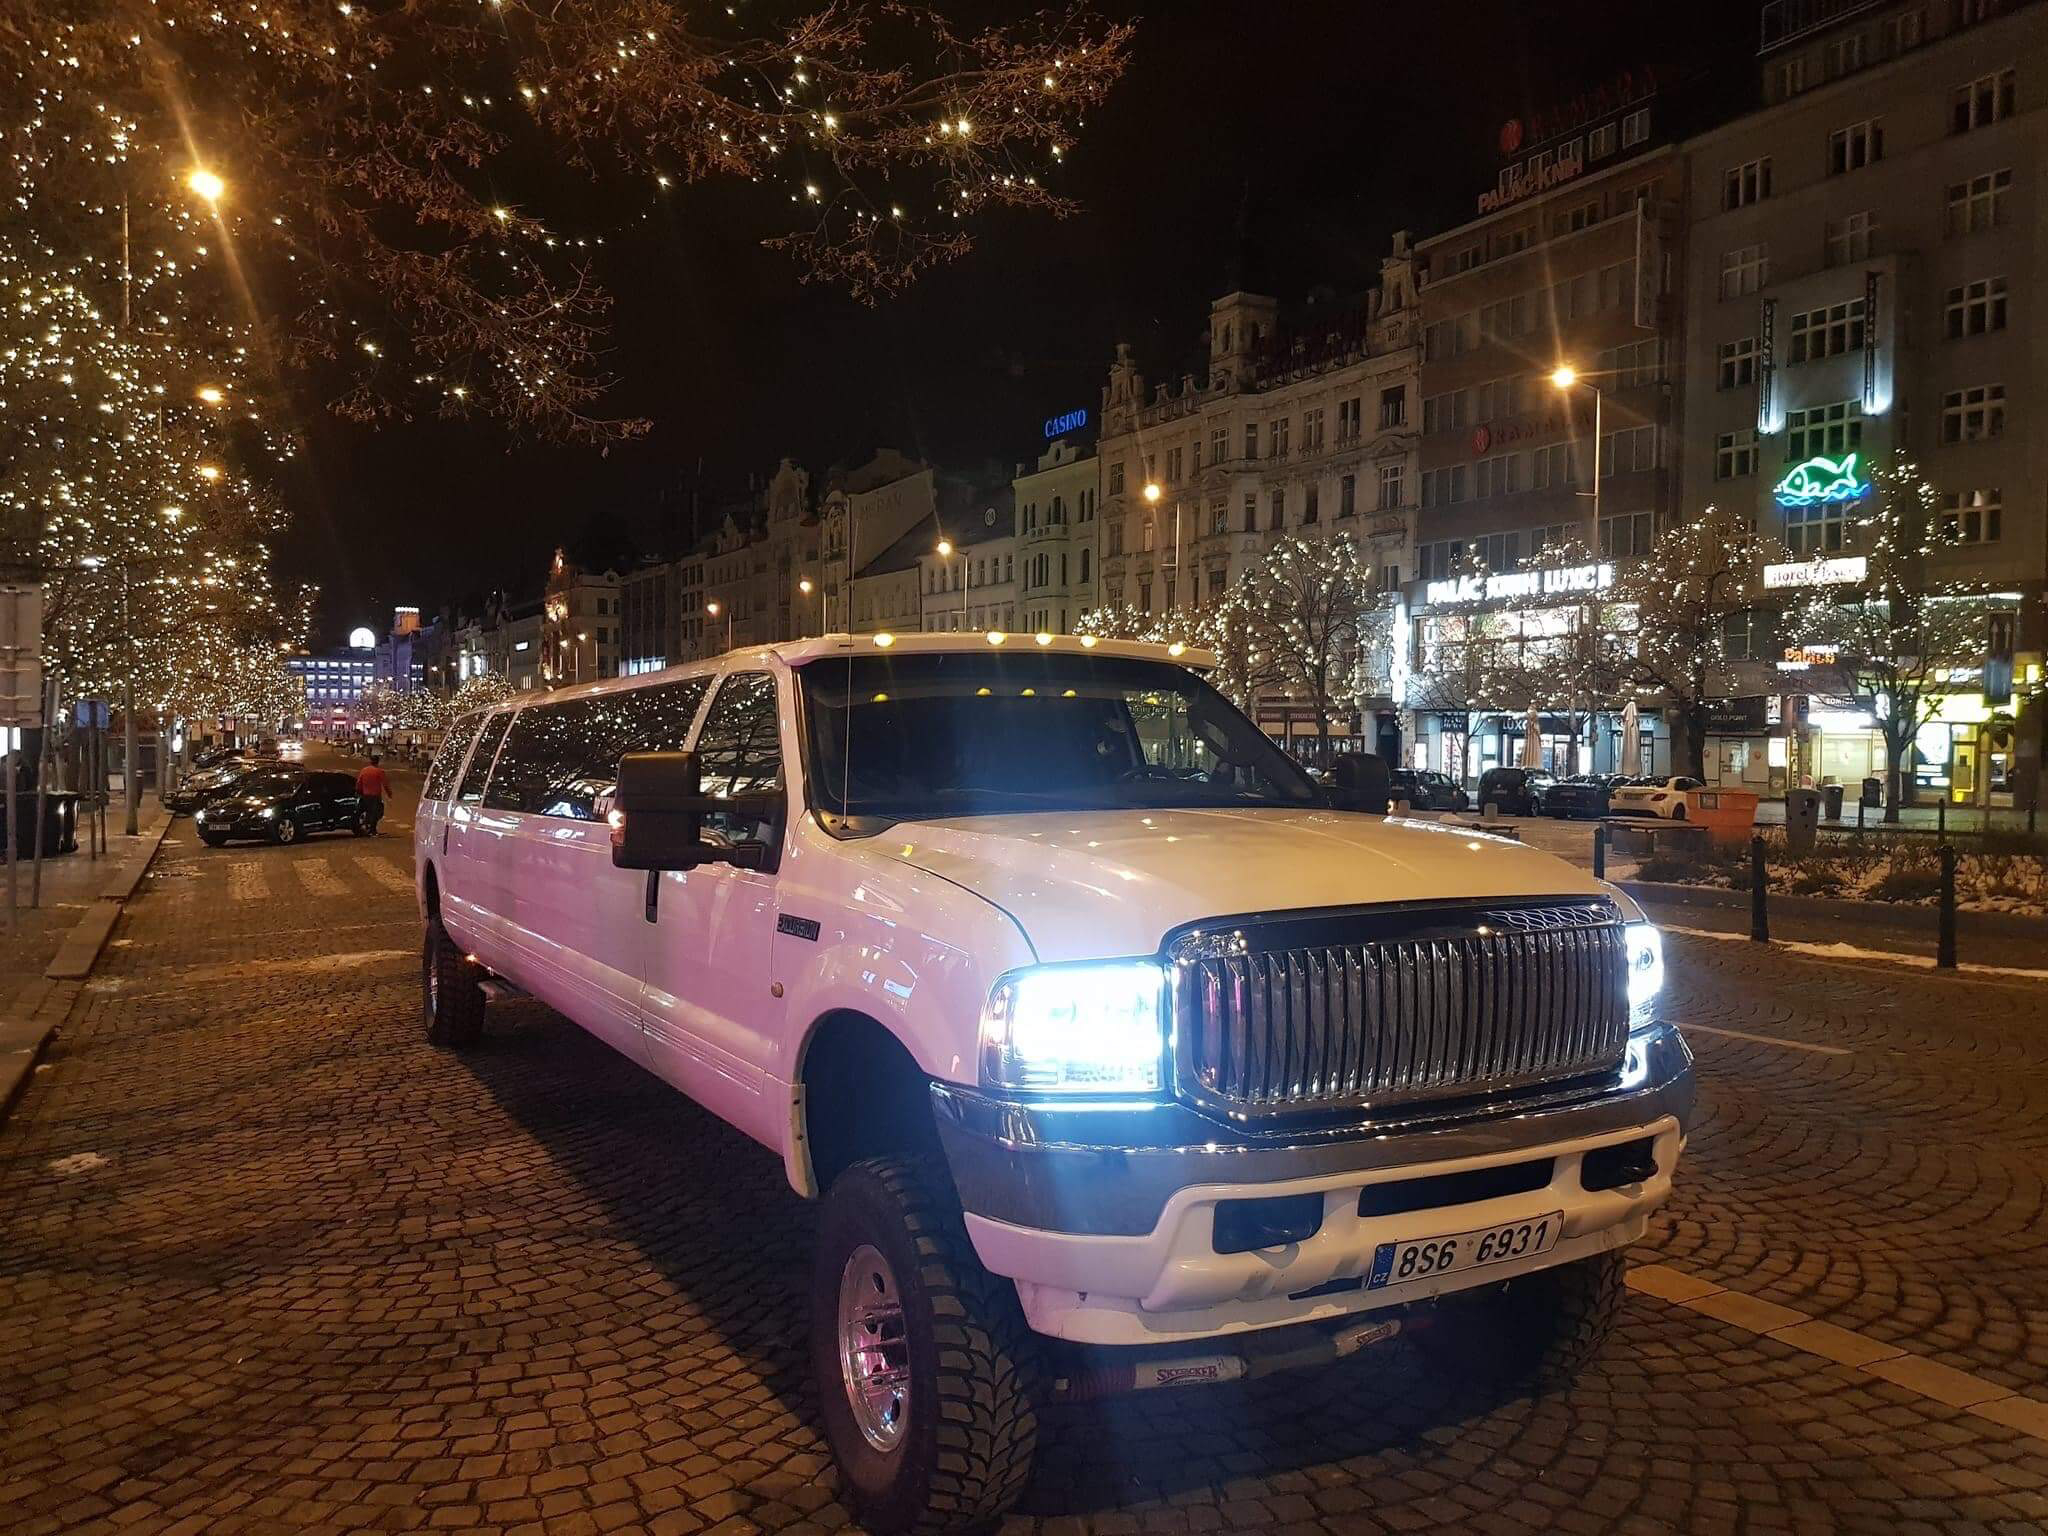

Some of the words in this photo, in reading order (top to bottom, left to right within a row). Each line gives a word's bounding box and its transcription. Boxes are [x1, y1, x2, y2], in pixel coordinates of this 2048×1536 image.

[1045, 409, 1086, 438] CASINO
[1398, 1240, 1457, 1278] 8S6
[1476, 1220, 1549, 1262] 6931
[1373, 1271, 1388, 1284] CZ
